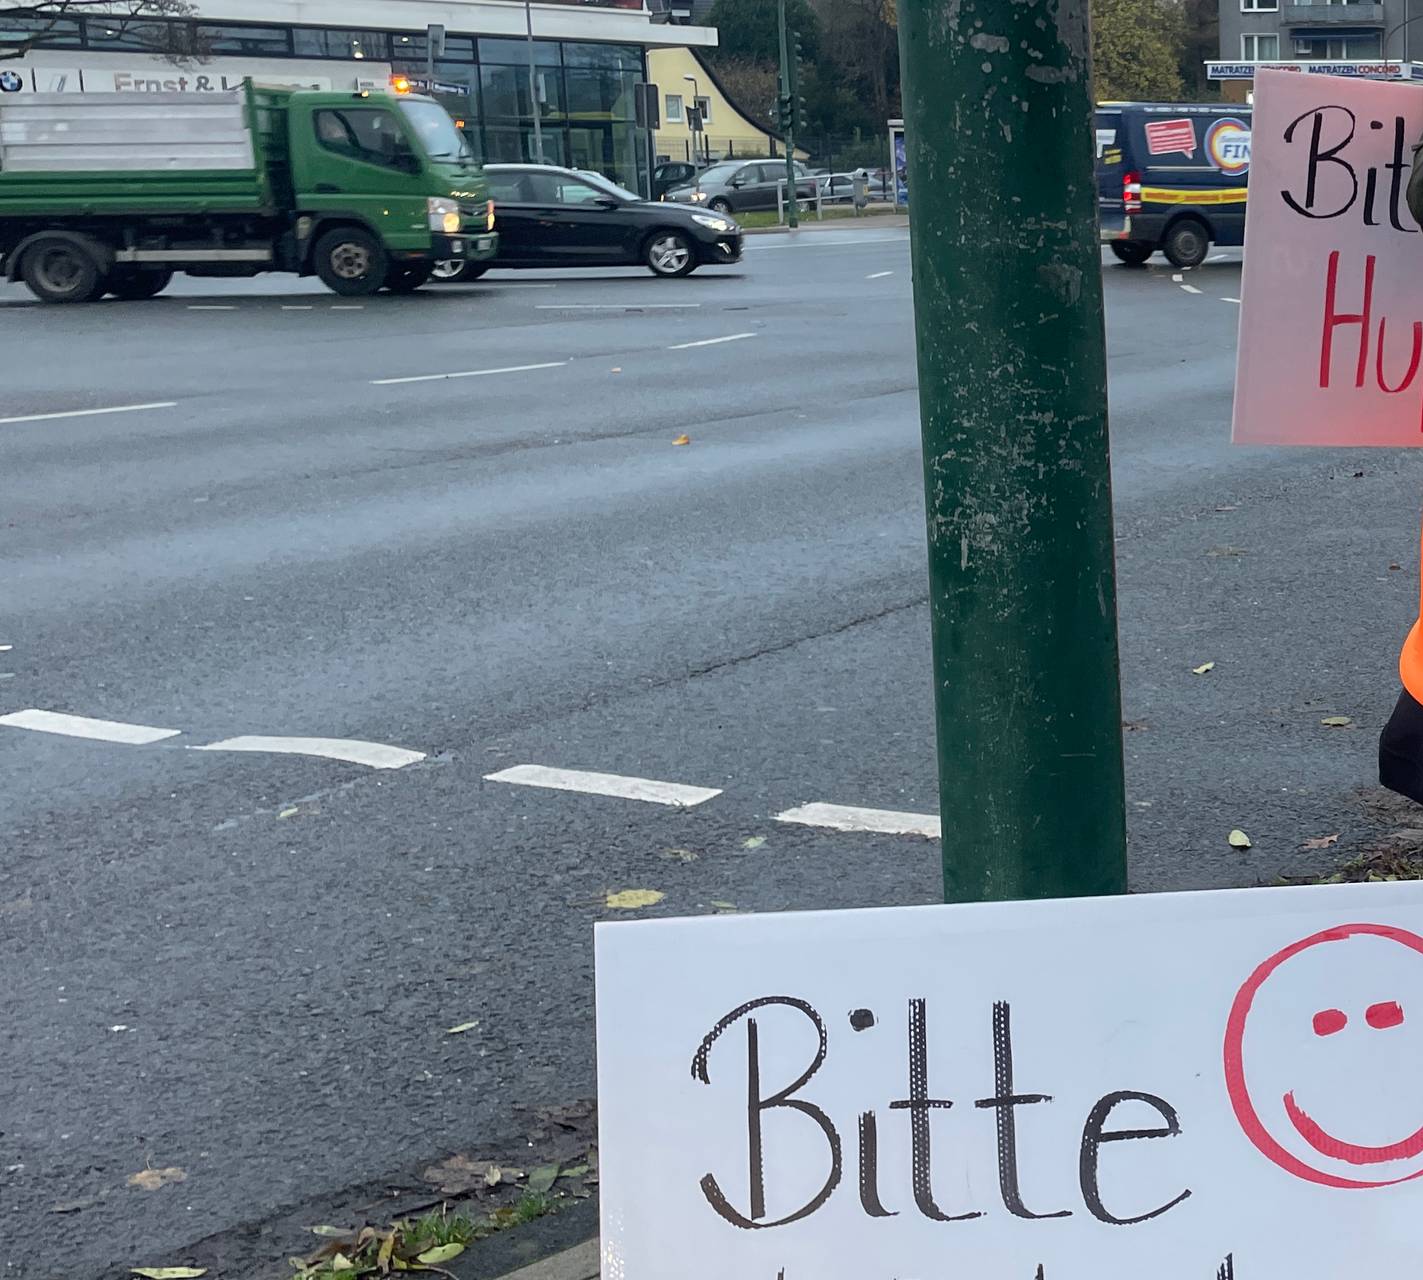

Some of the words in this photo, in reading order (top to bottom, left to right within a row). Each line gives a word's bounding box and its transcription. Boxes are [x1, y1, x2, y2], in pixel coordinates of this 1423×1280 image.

[1211, 66, 1255, 74] MATRATZE
[1309, 65, 1357, 73] MATRATZEN
[1359, 65, 1400, 73] CONCORD
[113, 71, 188, 93] Ernst
[1281, 106, 1418, 232] Bit
[691, 996, 1191, 1229] Bitte
